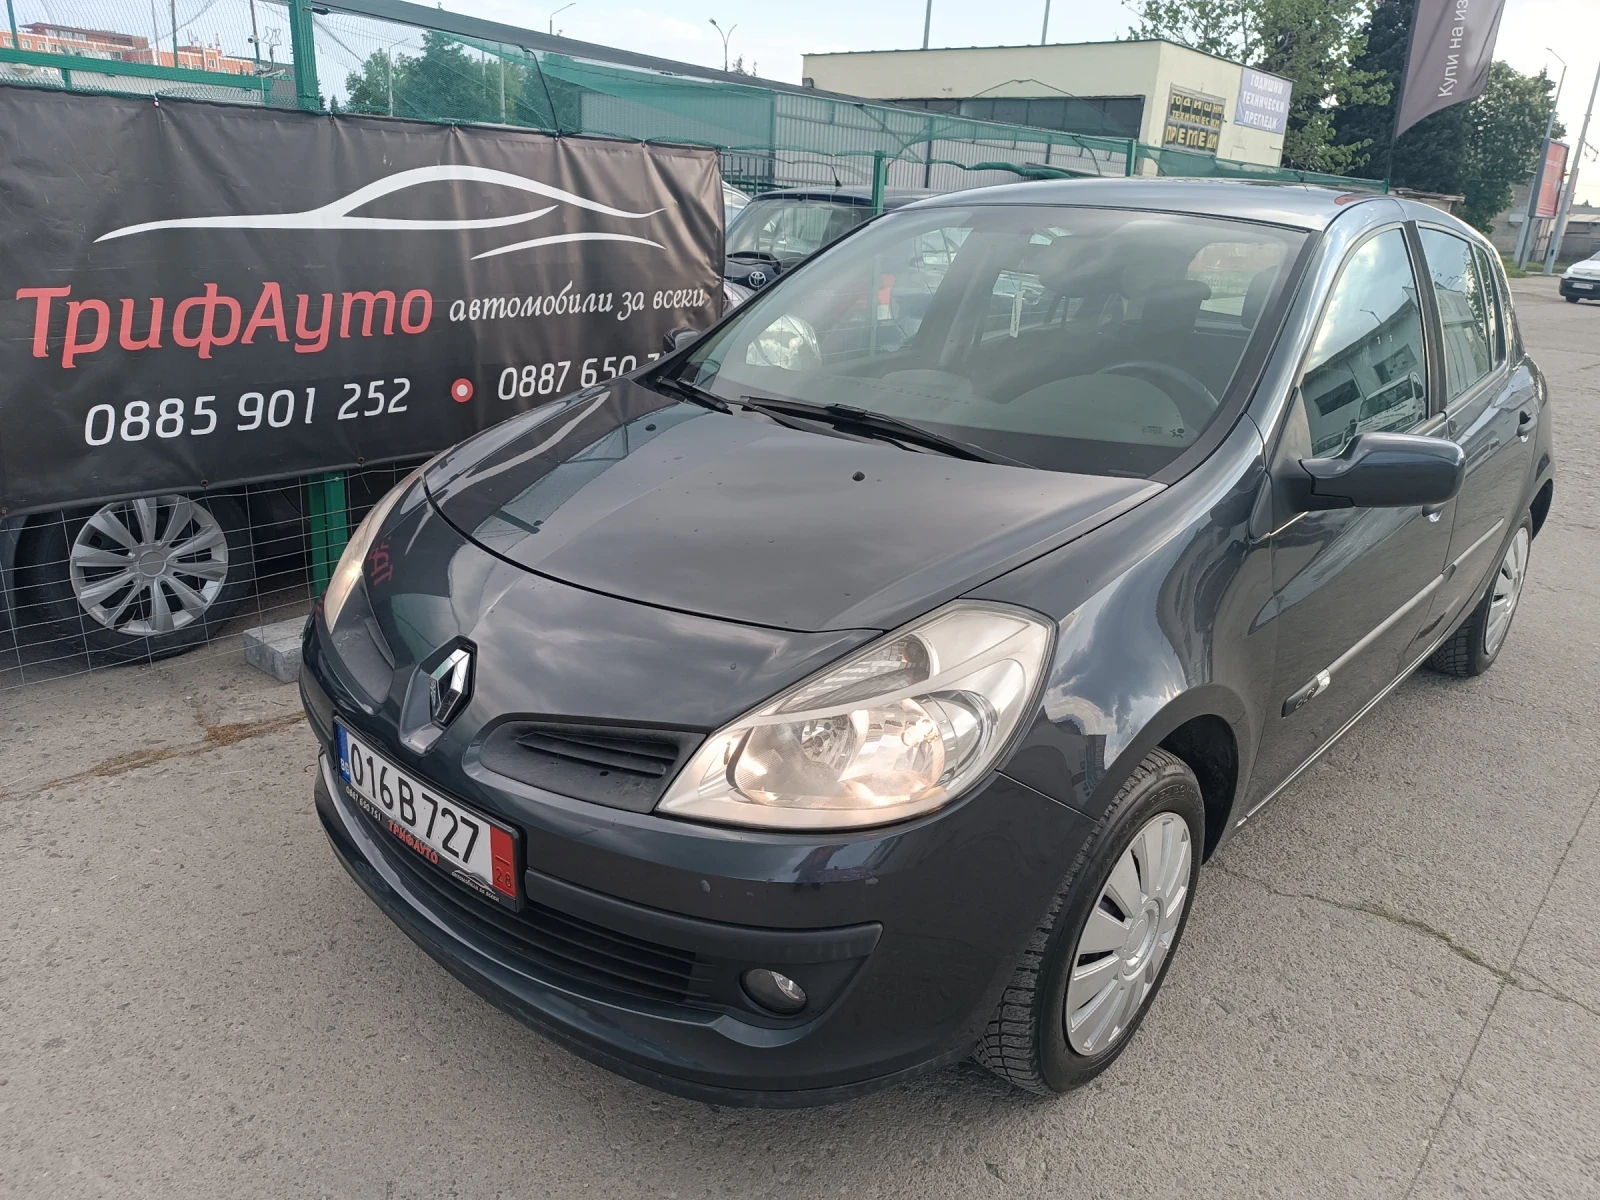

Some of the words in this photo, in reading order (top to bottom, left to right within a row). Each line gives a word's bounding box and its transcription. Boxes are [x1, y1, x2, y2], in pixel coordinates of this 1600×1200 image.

[1438, 54, 1460, 98] Купи
[1449, 26, 1465, 49] на
[1250, 73, 1284, 95] ГОДИШНИ
[1171, 95, 1223, 114] ГОДИШНИ
[1242, 91, 1286, 114] ТЕХНИЧЕСКИ
[1171, 110, 1221, 128] ТЕХНИЧЕСКИ
[1243, 110, 1278, 131] ПРЕГЛЕДИ
[449, 280, 614, 322] автомобили
[616, 290, 645, 321] за
[652, 287, 706, 310] всеки
[16, 281, 433, 369] ТрифАуто
[497, 360, 571, 401] 0887
[84, 395, 218, 446] 0885
[237, 387, 316, 432] 901
[337, 377, 411, 421] 252
[340, 757, 350, 775] BG
[388, 819, 440, 865] ТРИФАУТО
